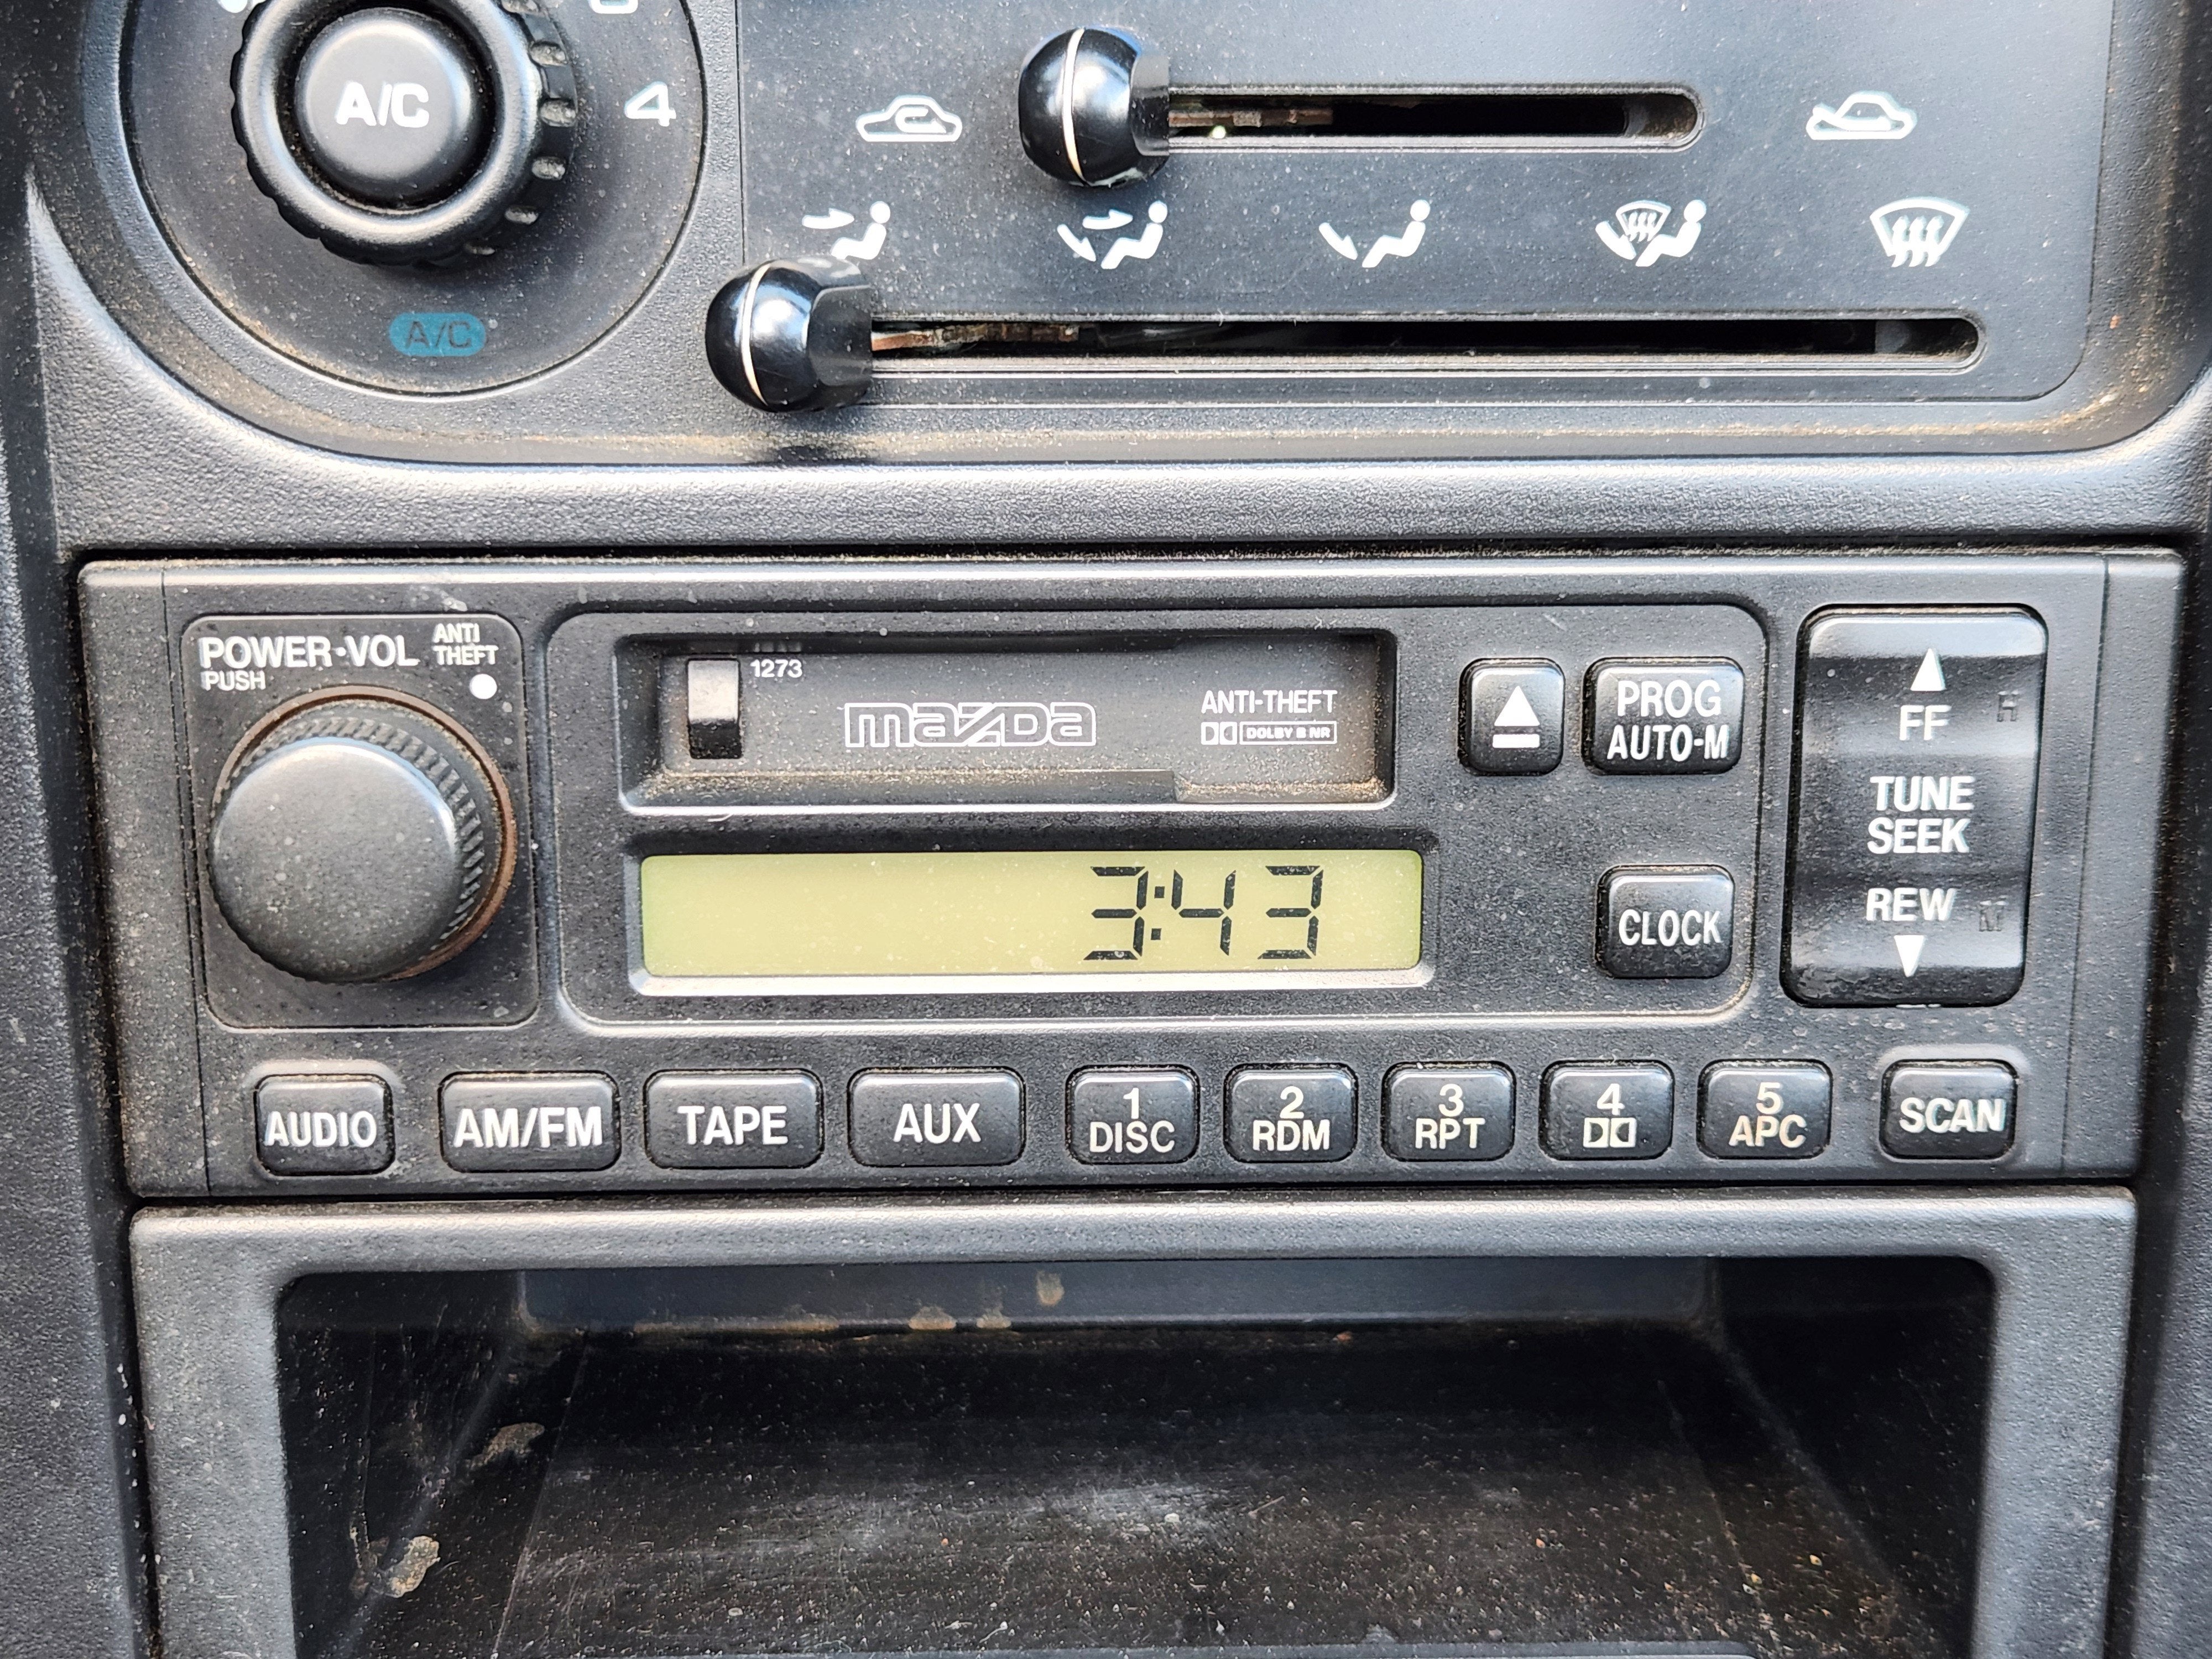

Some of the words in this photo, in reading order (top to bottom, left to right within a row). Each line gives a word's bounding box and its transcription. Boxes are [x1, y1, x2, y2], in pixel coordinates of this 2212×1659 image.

[335, 81, 429, 128] A/C
[624, 82, 676, 127] 4
[404, 319, 473, 349] A/C
[433, 623, 480, 643] ANTI
[432, 645, 498, 665] THEFT
[750, 659, 803, 678] 1273
[201, 670, 265, 691] PUSH
[1201, 690, 1337, 713] ANTI-THEFT
[1617, 680, 1721, 718] PROG
[1246, 727, 1293, 739] DOLBY
[1310, 727, 1331, 738] NR
[1899, 705, 1951, 740] FF
[1607, 725, 1728, 761] AUTO-M
[1870, 776, 1975, 812] TUNE
[1867, 817, 1970, 854] SEEK
[1083, 865, 1323, 959] 3:43
[1866, 888, 1957, 922] REW
[1619, 909, 1721, 946] CLOCK
[1123, 1088, 1139, 1119] 1
[1280, 1086, 1304, 1118] 2
[1439, 1083, 1463, 1115] 3
[1597, 1083, 1624, 1114] 4
[1756, 1082, 1783, 1113] 5
[265, 1111, 377, 1147] AUDIO
[454, 1107, 602, 1147] AM/FM
[677, 1105, 787, 1145] TAPE
[894, 1103, 980, 1143] AUX
[1729, 1114, 1806, 1147] APC
[1900, 1097, 2006, 1133] SCAN
[1090, 1121, 1174, 1153] DISC
[1253, 1120, 1329, 1151] RDM
[1416, 1118, 1485, 1149] RPT
